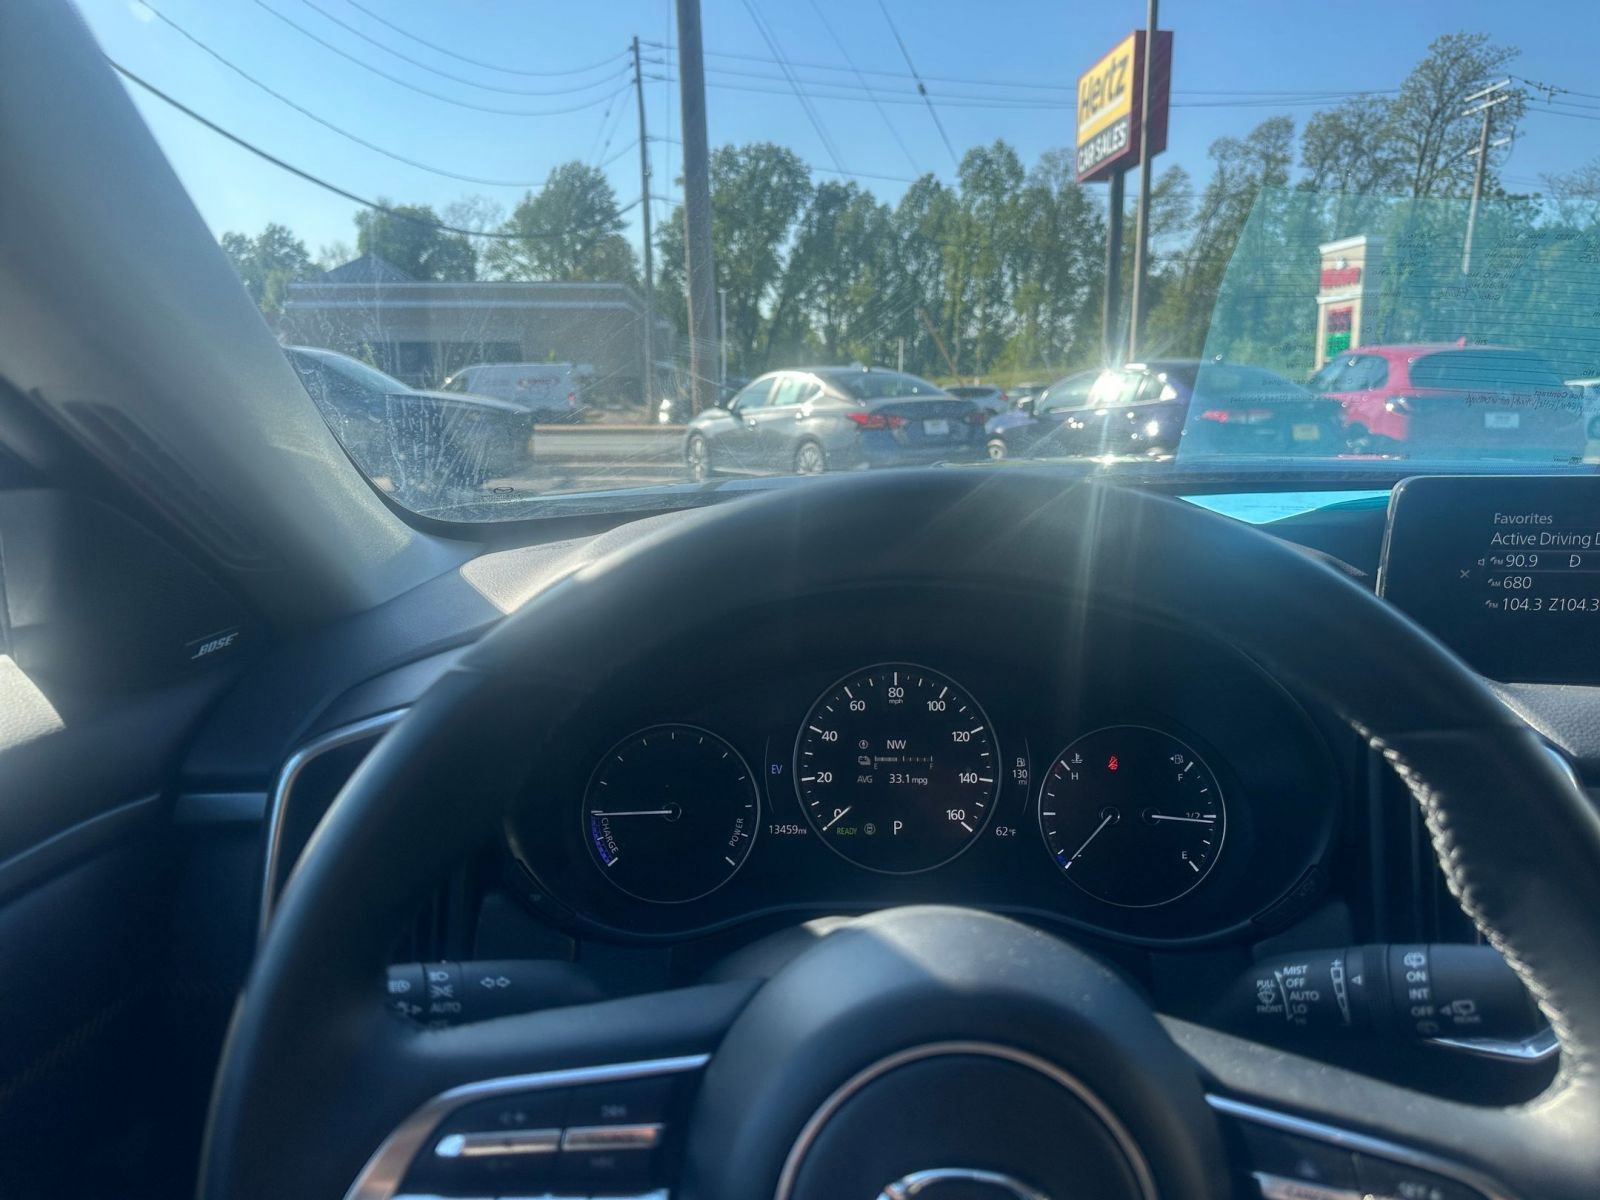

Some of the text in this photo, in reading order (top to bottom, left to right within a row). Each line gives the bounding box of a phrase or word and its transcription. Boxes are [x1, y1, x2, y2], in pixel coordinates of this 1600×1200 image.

[1078, 54, 1129, 123] Hertz
[1094, 122, 1127, 159] SALES
[1493, 512, 1553, 525] Favorites
[1490, 532, 1537, 546] Active
[1539, 532, 1591, 549] Driving
[1505, 554, 1538, 568] 90.9
[1503, 576, 1532, 589] 680
[1502, 597, 1542, 612] 104.3
[1548, 597, 1600, 612] Z104.3
[888, 687, 904, 698] 80
[849, 700, 866, 712] 60
[926, 700, 946, 712] 100
[821, 730, 838, 742] 40
[951, 731, 970, 743] 120
[886, 739, 907, 750] NW
[771, 764, 783, 775] EV
[1012, 769, 1028, 779] 130
[816, 771, 833, 783] 20
[857, 775, 873, 784] AVG
[889, 773, 928, 786] 33.1 mpg
[958, 772, 978, 784] 140
[1071, 772, 1079, 781] H
[1177, 774, 1184, 782] F
[946, 809, 965, 821] 160
[728, 817, 745, 847] POWER
[836, 826, 857, 836] READY
[893, 820, 903, 835] P
[601, 817, 619, 854] CHARGE
[1181, 851, 1188, 860] E
[1282, 964, 1308, 976] MIST
[1406, 971, 1426, 982] ON
[1285, 977, 1305, 989] OFF
[1289, 990, 1320, 1001] AUTO
[1409, 987, 1429, 1000] INT
